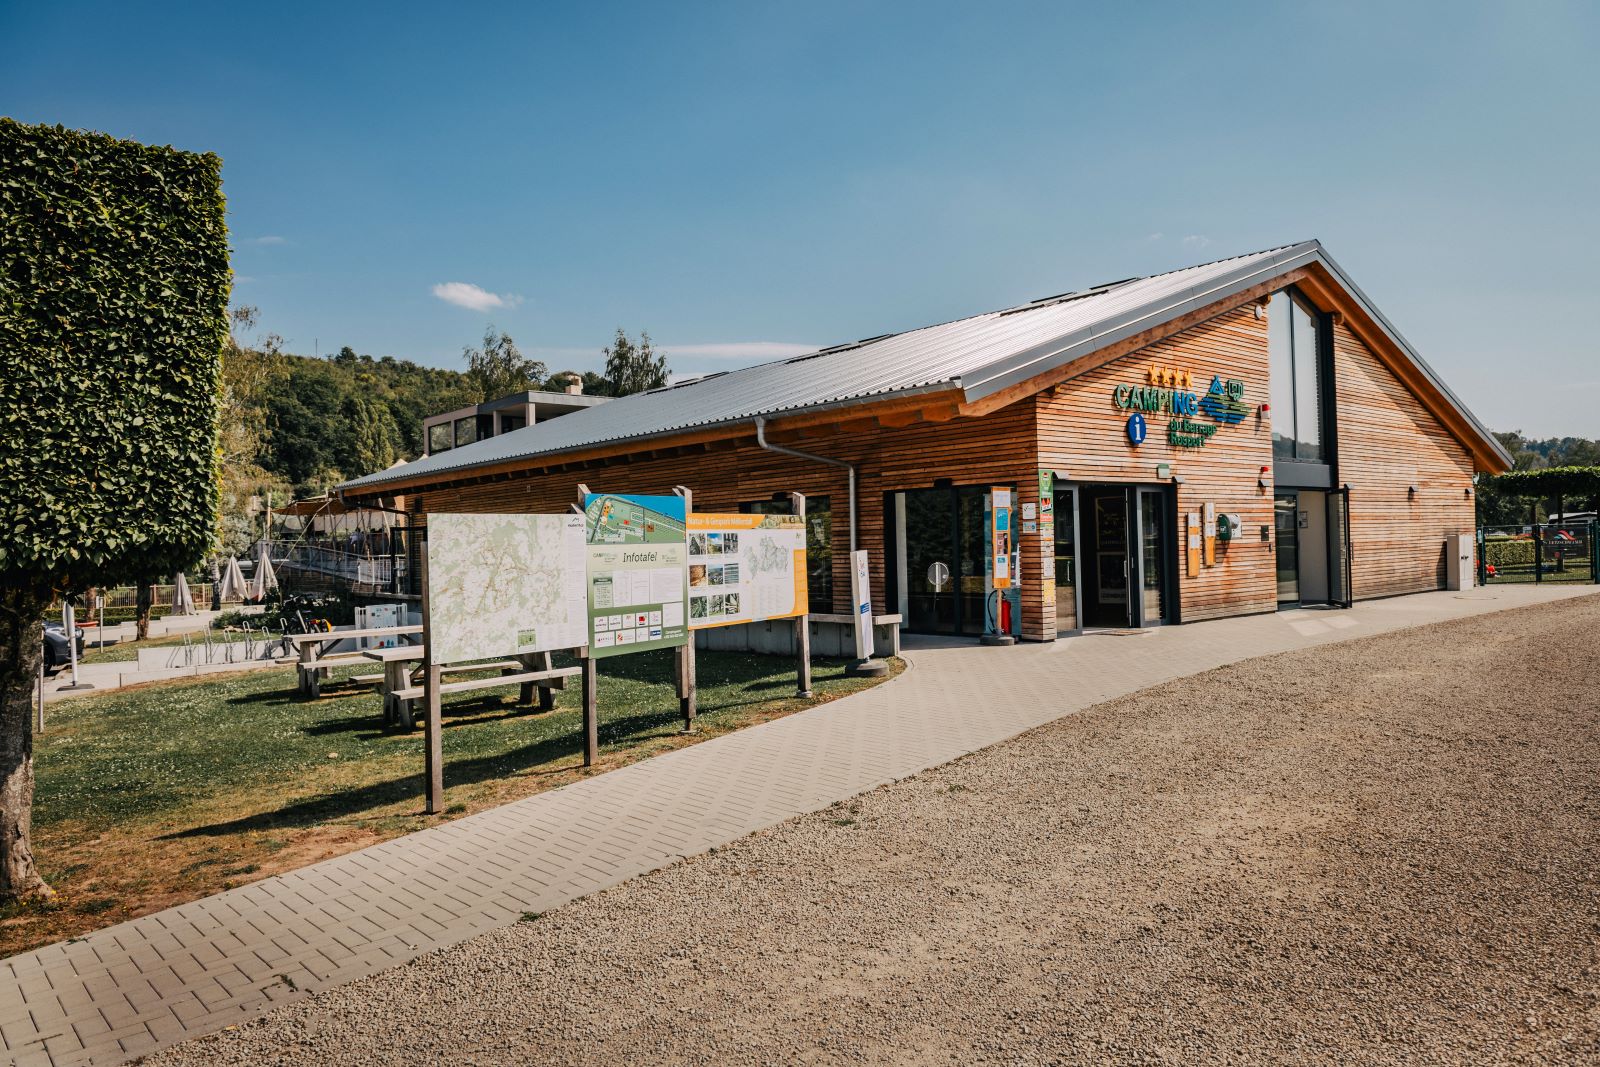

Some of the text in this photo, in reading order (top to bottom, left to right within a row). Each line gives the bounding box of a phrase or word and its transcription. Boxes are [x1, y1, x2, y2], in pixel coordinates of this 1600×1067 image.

[1115, 383, 1199, 416] CAMPING
[1170, 417, 1217, 437] du Barrage
[1170, 432, 1206, 448] Rosport
[622, 552, 658, 563] Infotafel
